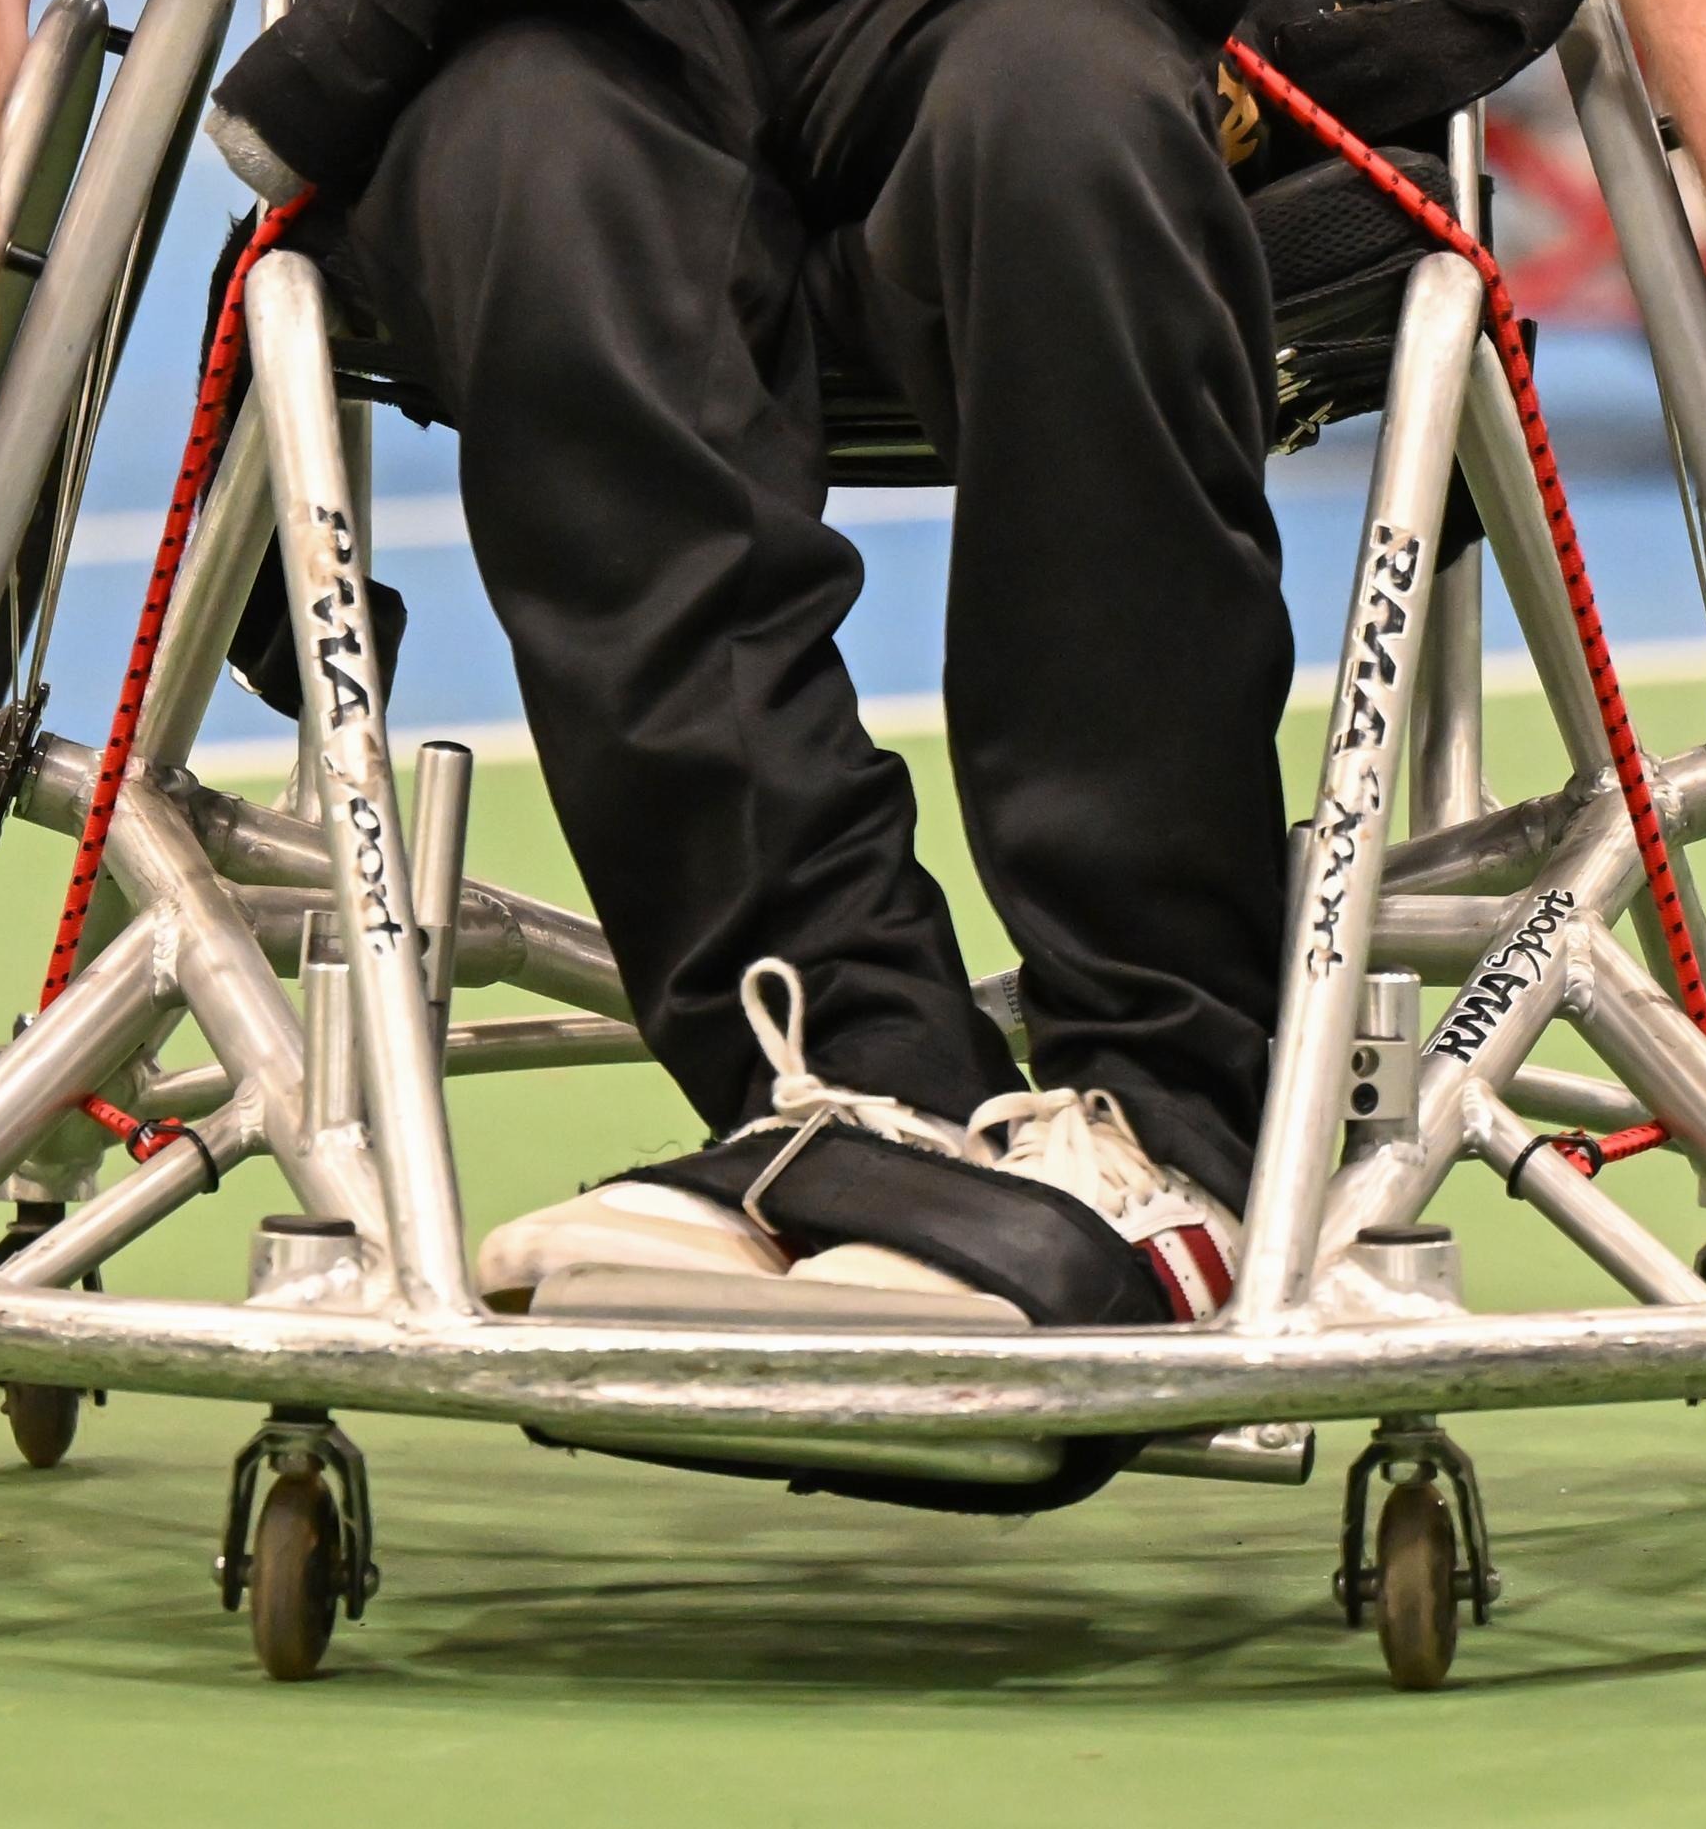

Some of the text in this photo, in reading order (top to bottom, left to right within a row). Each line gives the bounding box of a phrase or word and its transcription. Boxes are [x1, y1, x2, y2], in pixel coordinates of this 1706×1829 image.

[1333, 524, 1420, 755] RMA
[1433, 889, 1575, 1064] RMA Sport
